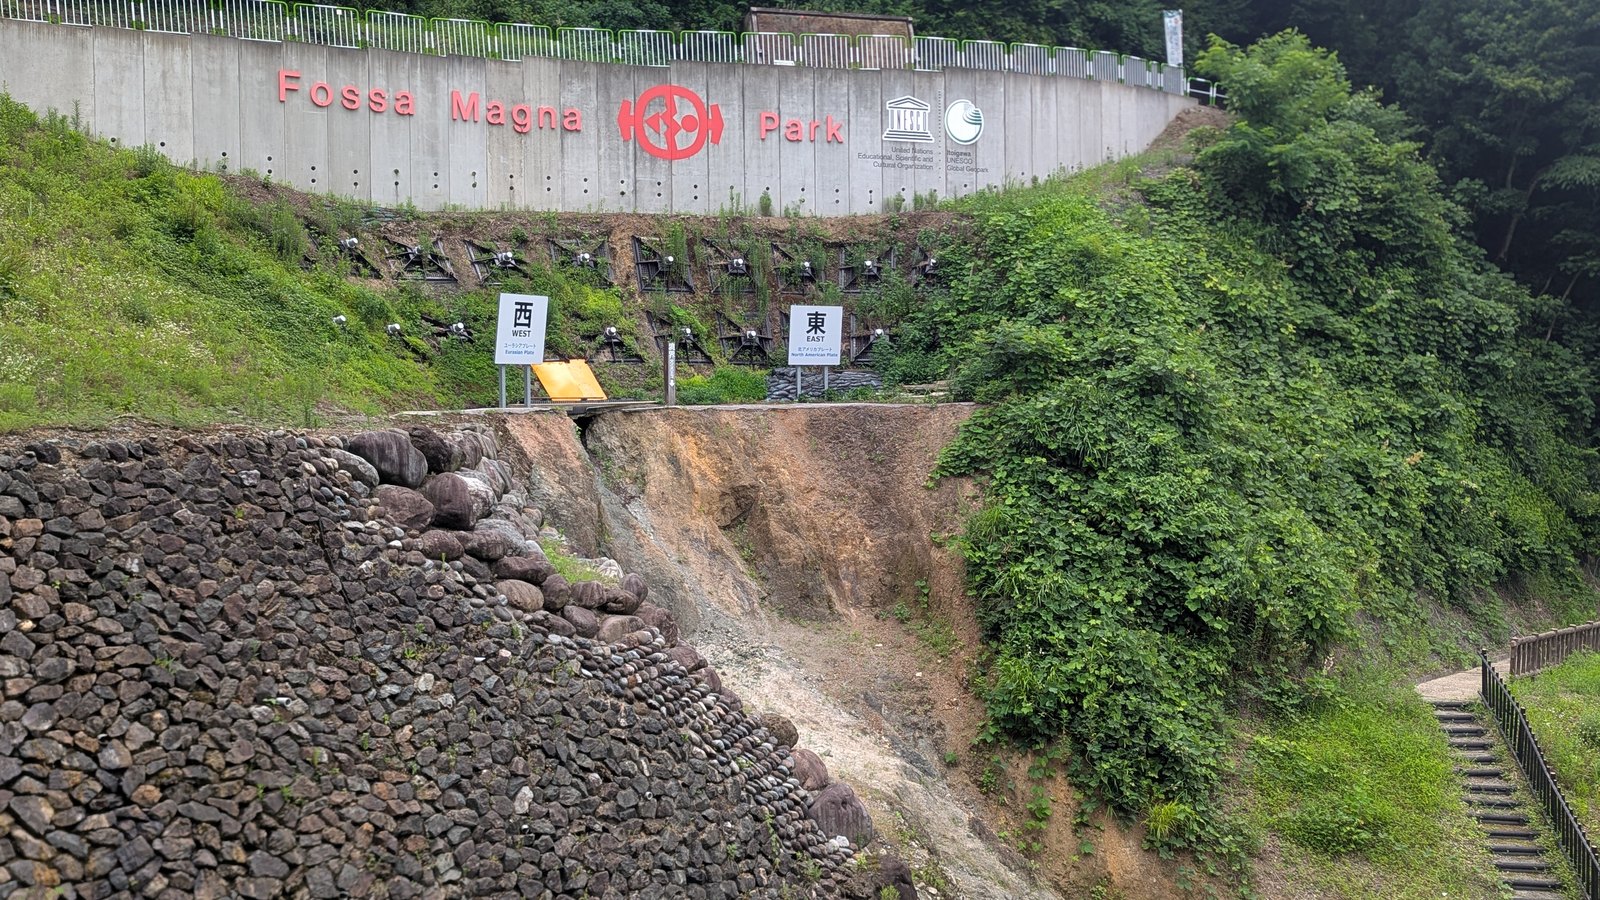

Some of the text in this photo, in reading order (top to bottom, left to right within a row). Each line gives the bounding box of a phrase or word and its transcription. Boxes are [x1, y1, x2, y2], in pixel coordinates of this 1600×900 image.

[278, 70, 416, 116] Fossa
[451, 90, 582, 133] Magna
[759, 111, 844, 143] Park
[891, 146, 910, 154] United
[912, 147, 934, 155] Nations
[857, 152, 894, 160] Educational,
[895, 154, 921, 162] Scientific
[896, 162, 934, 170] Organization
[514, 302, 533, 328] 西
[806, 311, 826, 334] 東
